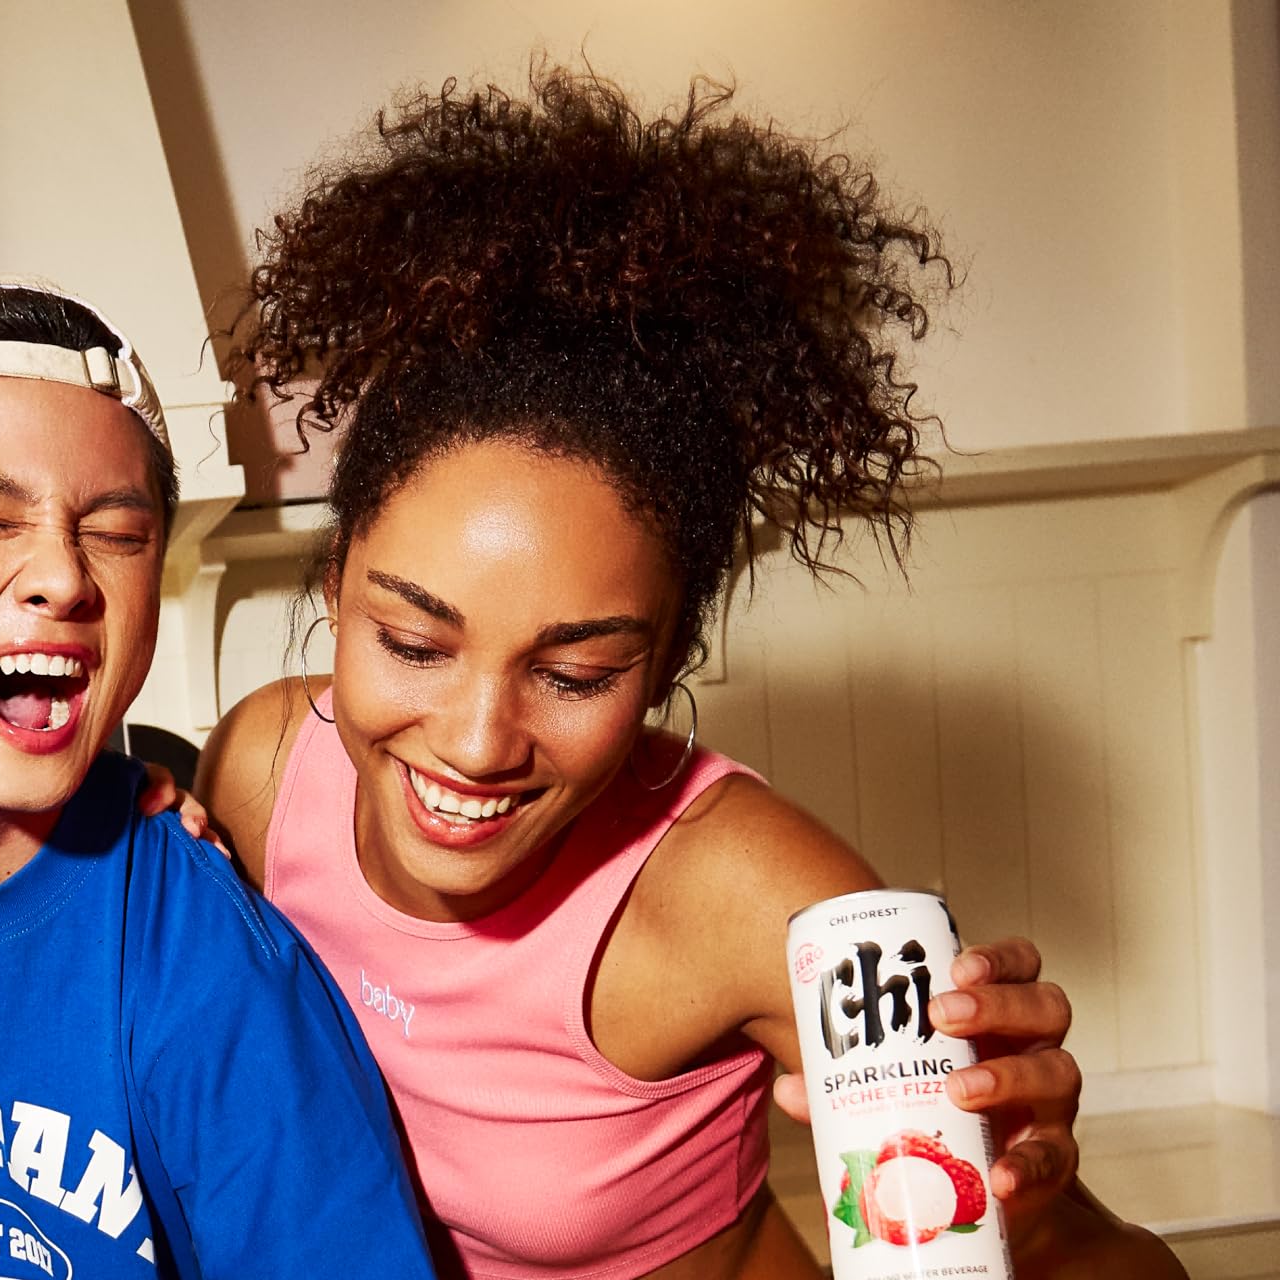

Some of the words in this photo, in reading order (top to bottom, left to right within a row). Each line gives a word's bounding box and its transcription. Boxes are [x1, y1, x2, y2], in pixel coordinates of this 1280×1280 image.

[829, 915, 848, 927] CHI
[851, 907, 899, 921] FOREST
[361, 969, 415, 1039] baby
[823, 1058, 953, 1094] SPARKLING
[831, 1086, 897, 1111] LYCHEE
[903, 1080, 946, 1097] FIZZ
[941, 1264, 989, 1277] BEVERAGE
